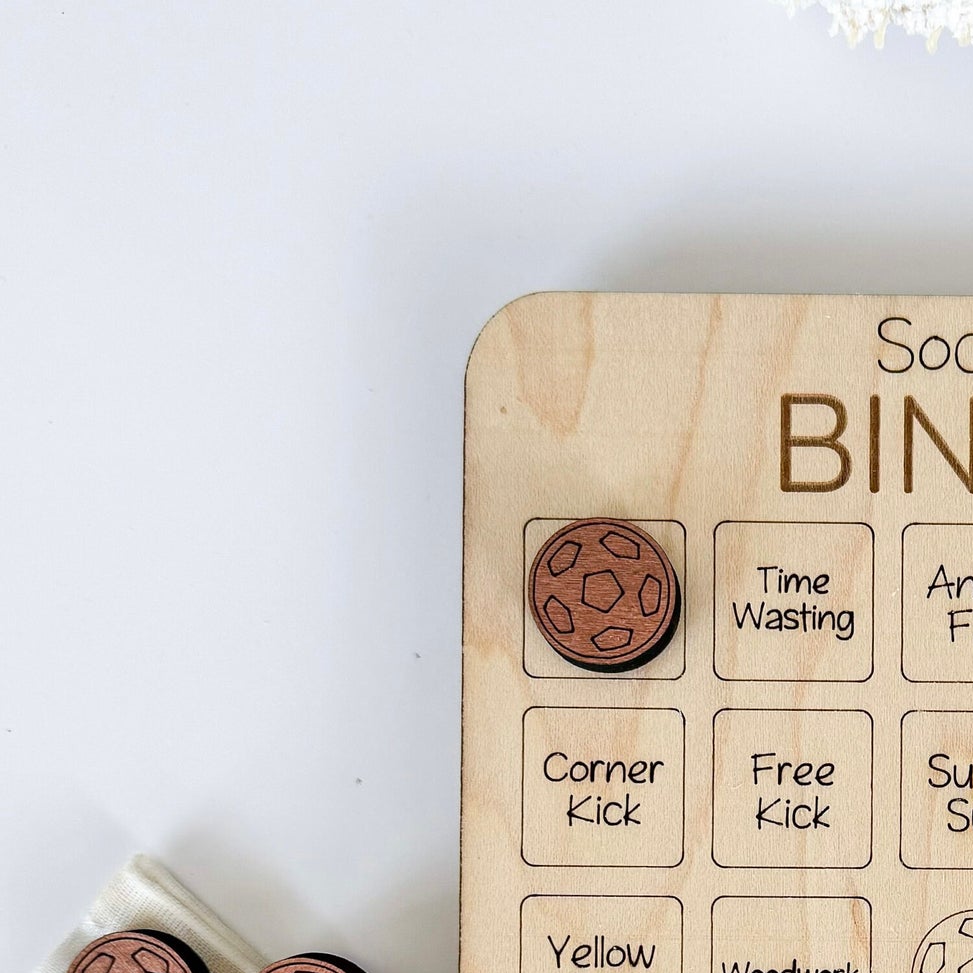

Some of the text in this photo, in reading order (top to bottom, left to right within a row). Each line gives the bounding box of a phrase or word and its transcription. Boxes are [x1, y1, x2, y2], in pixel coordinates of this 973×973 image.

[757, 566, 829, 594] Time
[733, 601, 854, 641] Wasting
[544, 752, 664, 783] Corner
[751, 753, 835, 786] Free
[567, 793, 641, 826] Kick
[756, 796, 830, 830] Kick
[548, 935, 655, 969] Yellow
